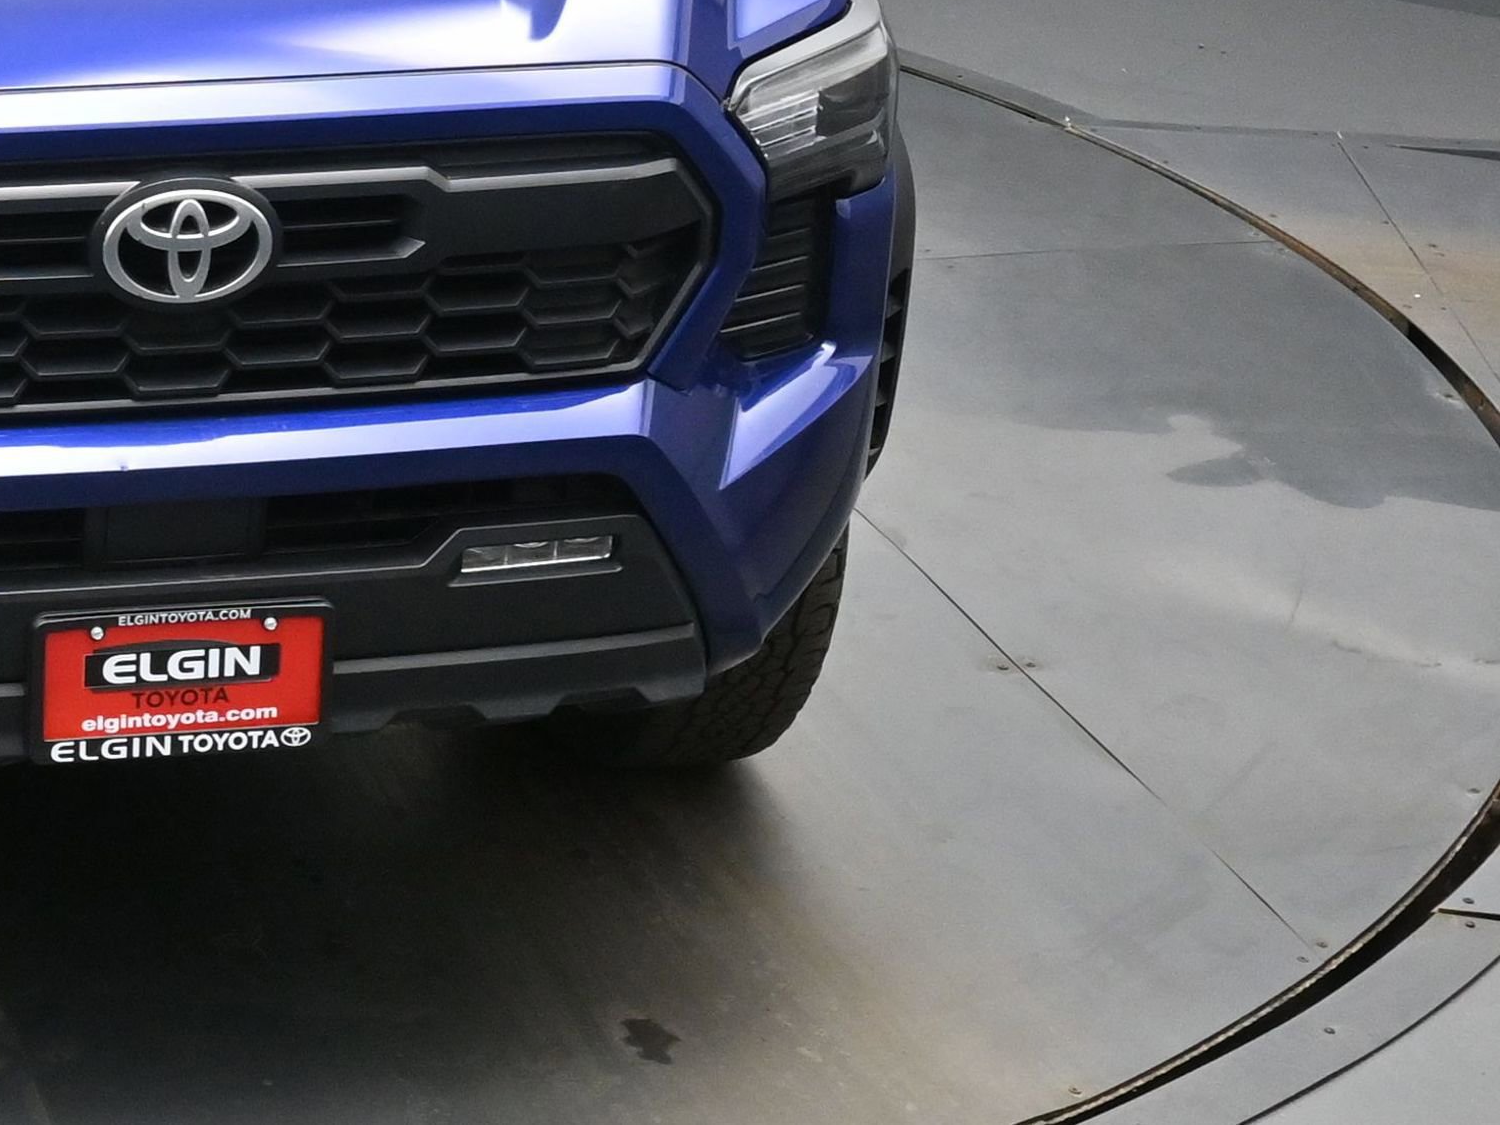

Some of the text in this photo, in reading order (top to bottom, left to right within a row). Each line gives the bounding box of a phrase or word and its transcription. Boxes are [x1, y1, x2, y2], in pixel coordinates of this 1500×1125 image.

[117, 608, 252, 627] ELGINTOYOTA.COM
[102, 645, 261, 685] ELGIN
[131, 687, 229, 709] TOYOTA
[81, 706, 278, 733] elgintoyota.com
[50, 730, 280, 763] ELGIN TOYOTA
